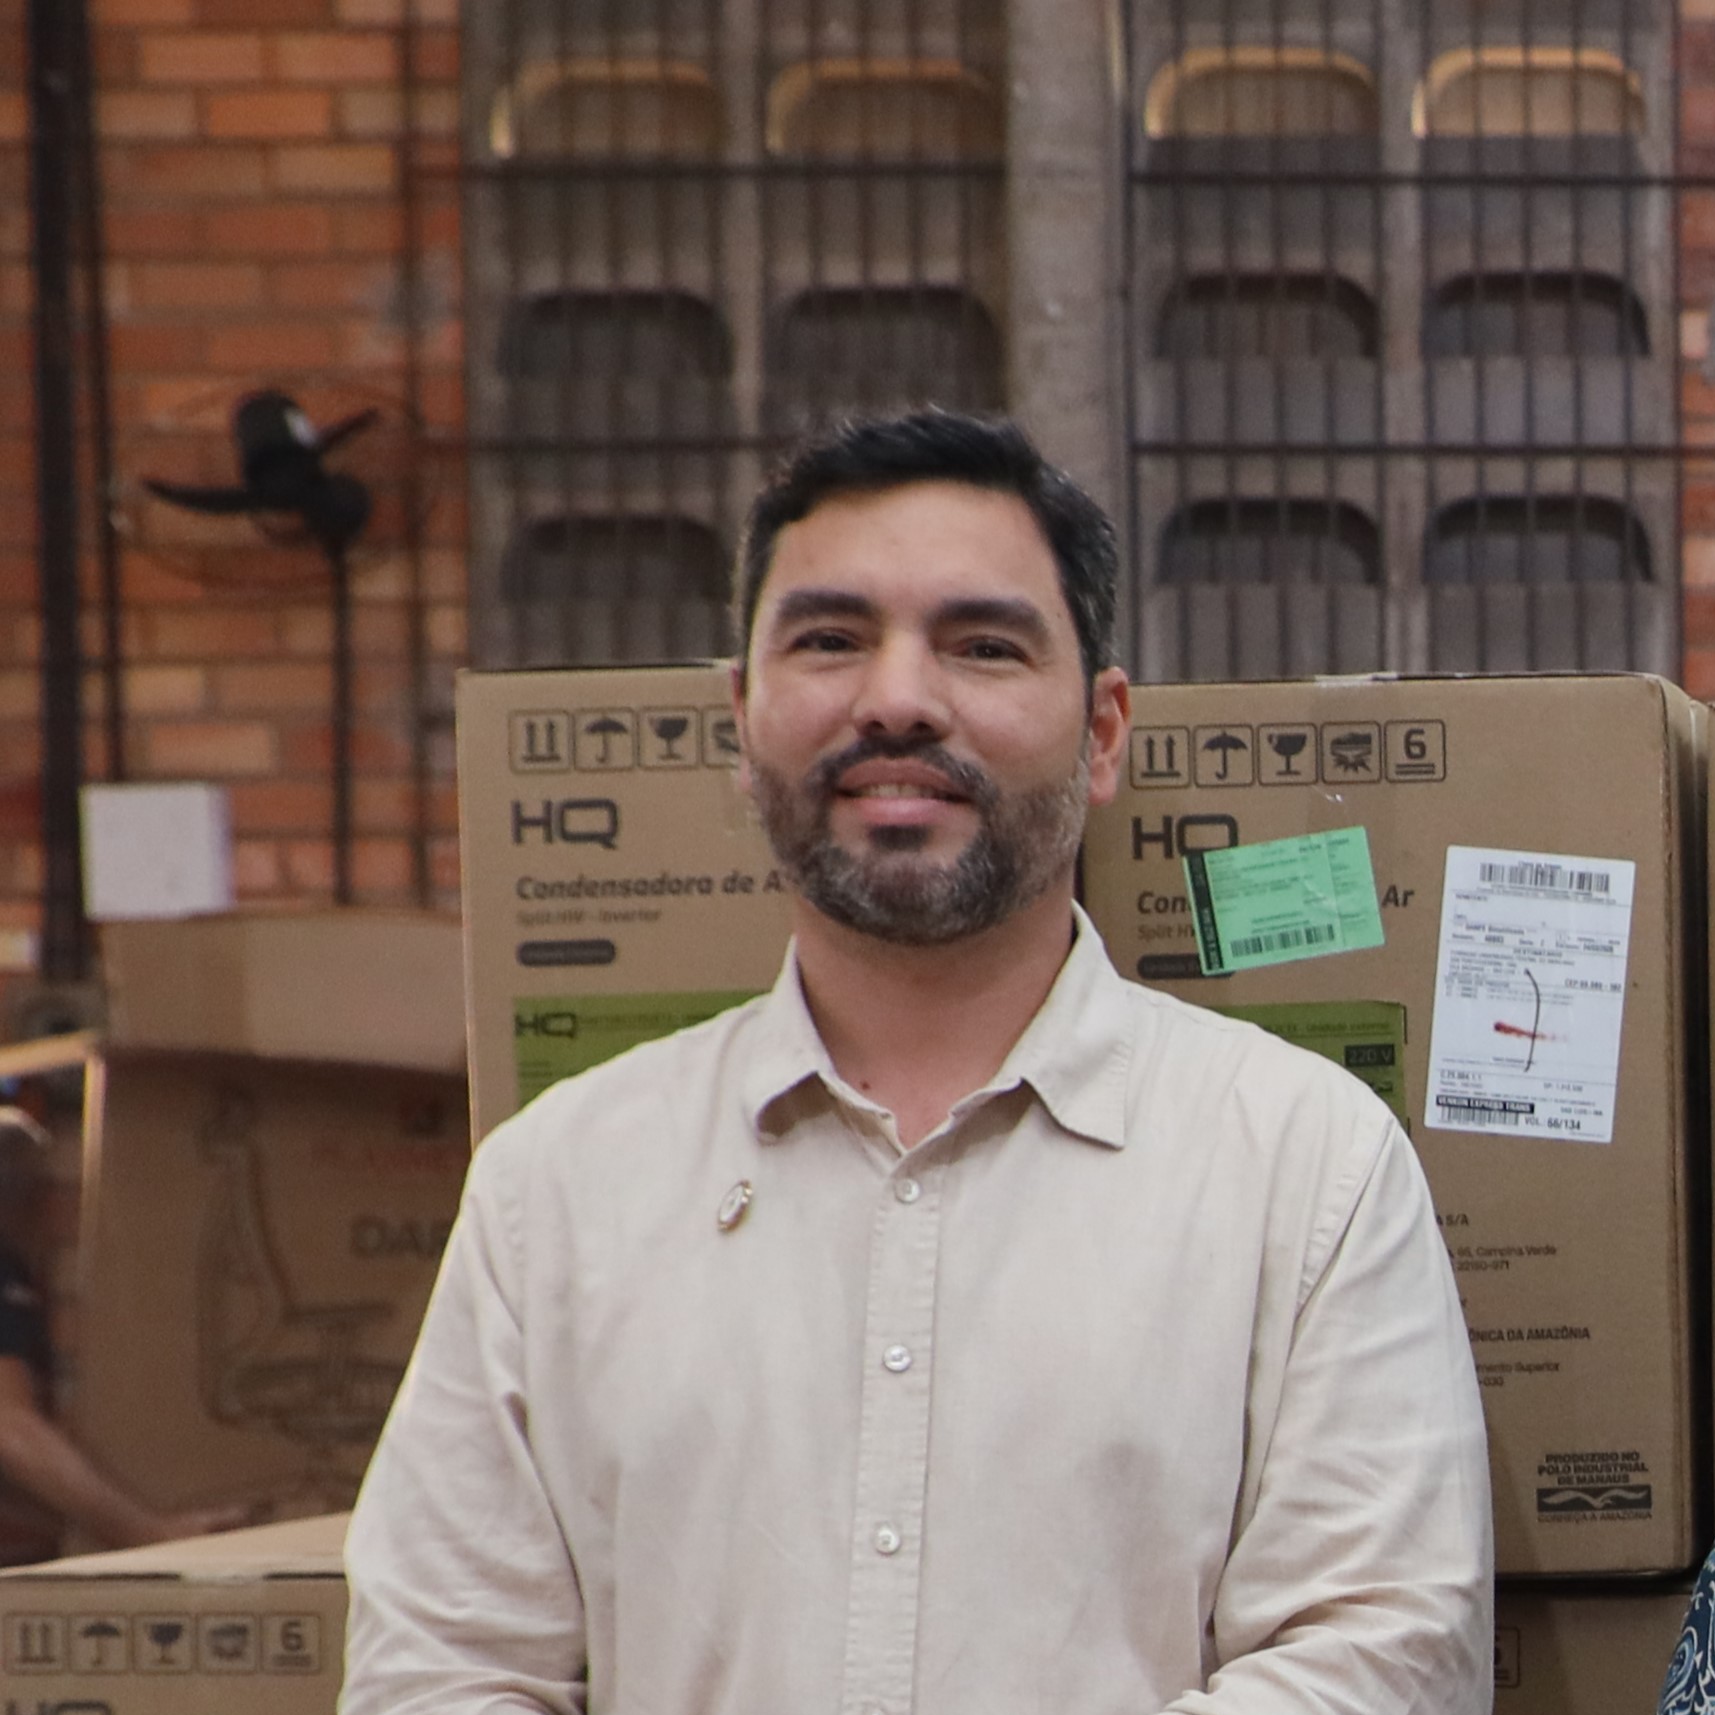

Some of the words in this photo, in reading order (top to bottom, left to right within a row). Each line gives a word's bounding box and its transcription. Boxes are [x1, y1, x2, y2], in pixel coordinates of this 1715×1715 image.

[1404, 729, 1426, 760] 6
[512, 799, 618, 849] HQ
[516, 873, 714, 900] Condensadora
[721, 871, 755, 894] de
[763, 869, 793, 893] A
[1381, 884, 1414, 908] Ar
[515, 1012, 577, 1038] HQ
[1477, 1245, 1524, 1259] Campina
[1527, 1244, 1558, 1257] Verde
[1469, 1328, 1505, 1341] ÔNICA
[1507, 1328, 1525, 1341] DA
[1527, 1325, 1591, 1341] AMAZÔNIA
[1477, 1362, 1512, 1372] mento
[1545, 1453, 1619, 1463] PRODUZIDO
[1621, 1451, 1640, 1461] NO
[1537, 1464, 1571, 1475] POLO
[1574, 1462, 1649, 1473] INDUSTRIAL
[1557, 1476, 1574, 1485] DE
[1576, 1474, 1630, 1484] MANAUS
[281, 1622, 305, 1652] 6
